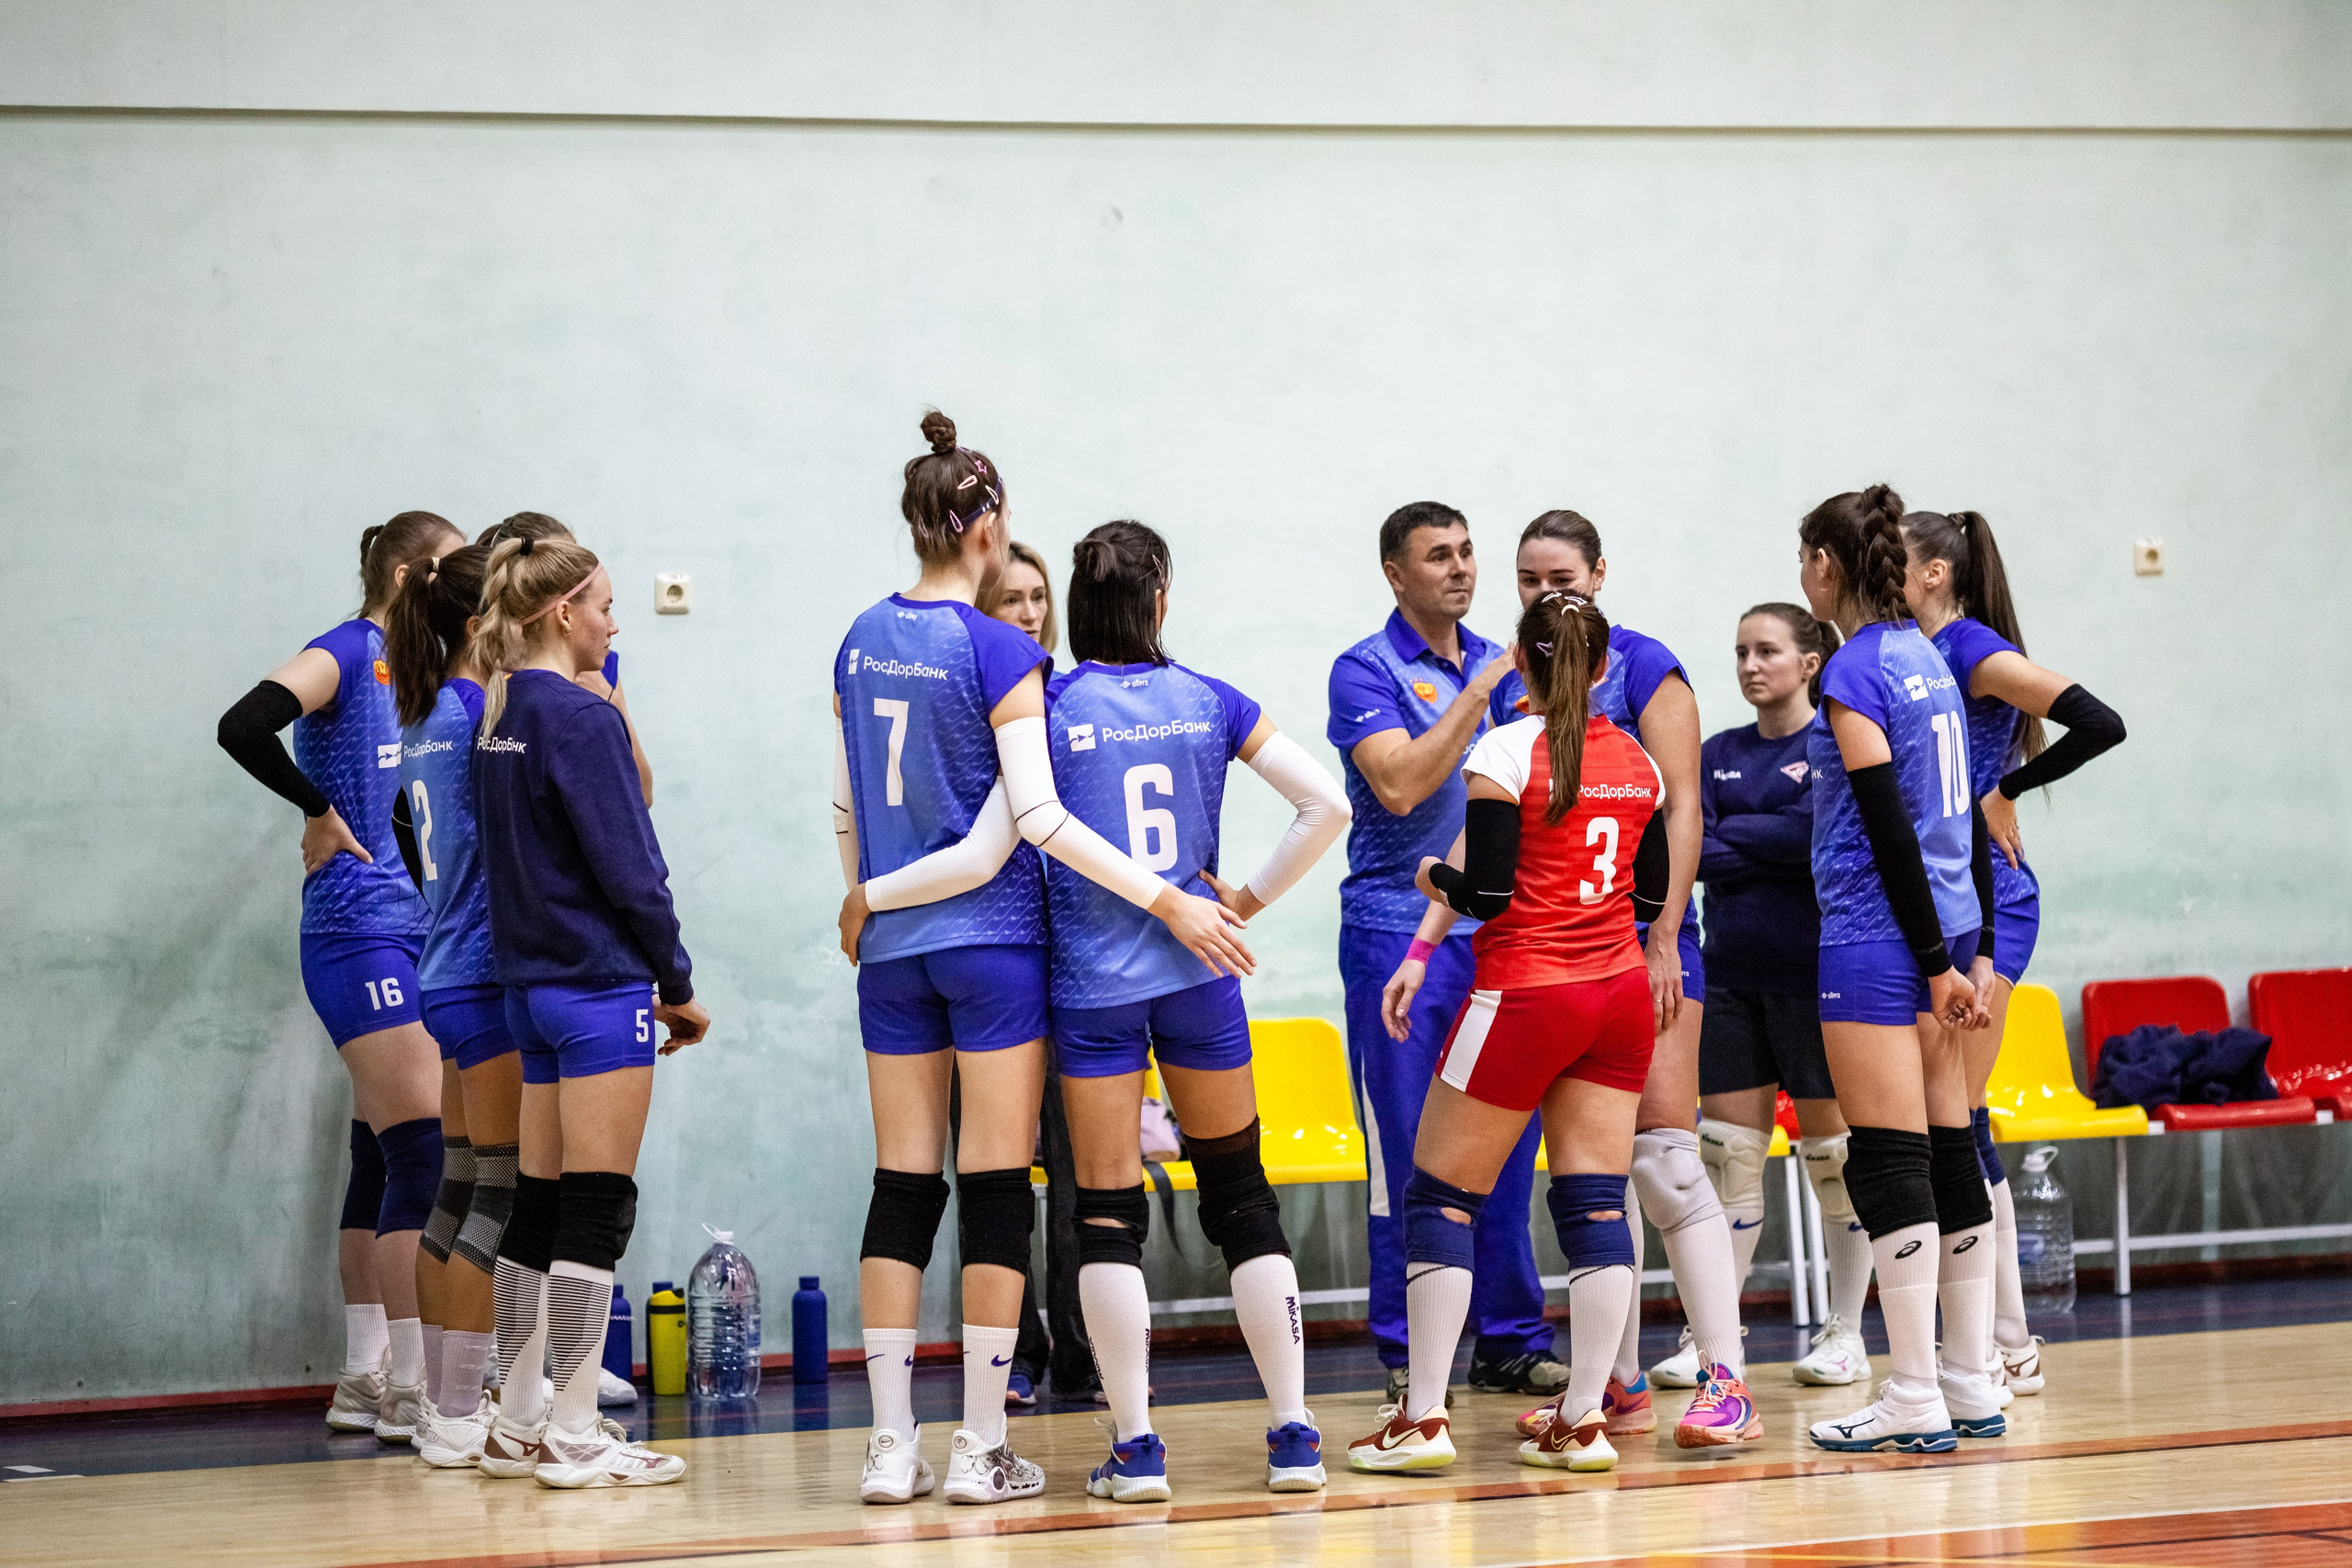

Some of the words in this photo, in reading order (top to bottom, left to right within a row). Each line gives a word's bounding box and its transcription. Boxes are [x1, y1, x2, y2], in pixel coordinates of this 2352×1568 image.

[863, 656, 949, 681] РосДорБанк
[874, 697, 910, 807] 7
[1102, 719, 1212, 742] РосДорБанк
[1931, 710, 1970, 818] 10
[413, 779, 438, 881] 2
[1123, 762, 1178, 873] 6
[1579, 817, 1619, 905] 3
[365, 977, 404, 1010] 16
[636, 1009, 649, 1043] 5
